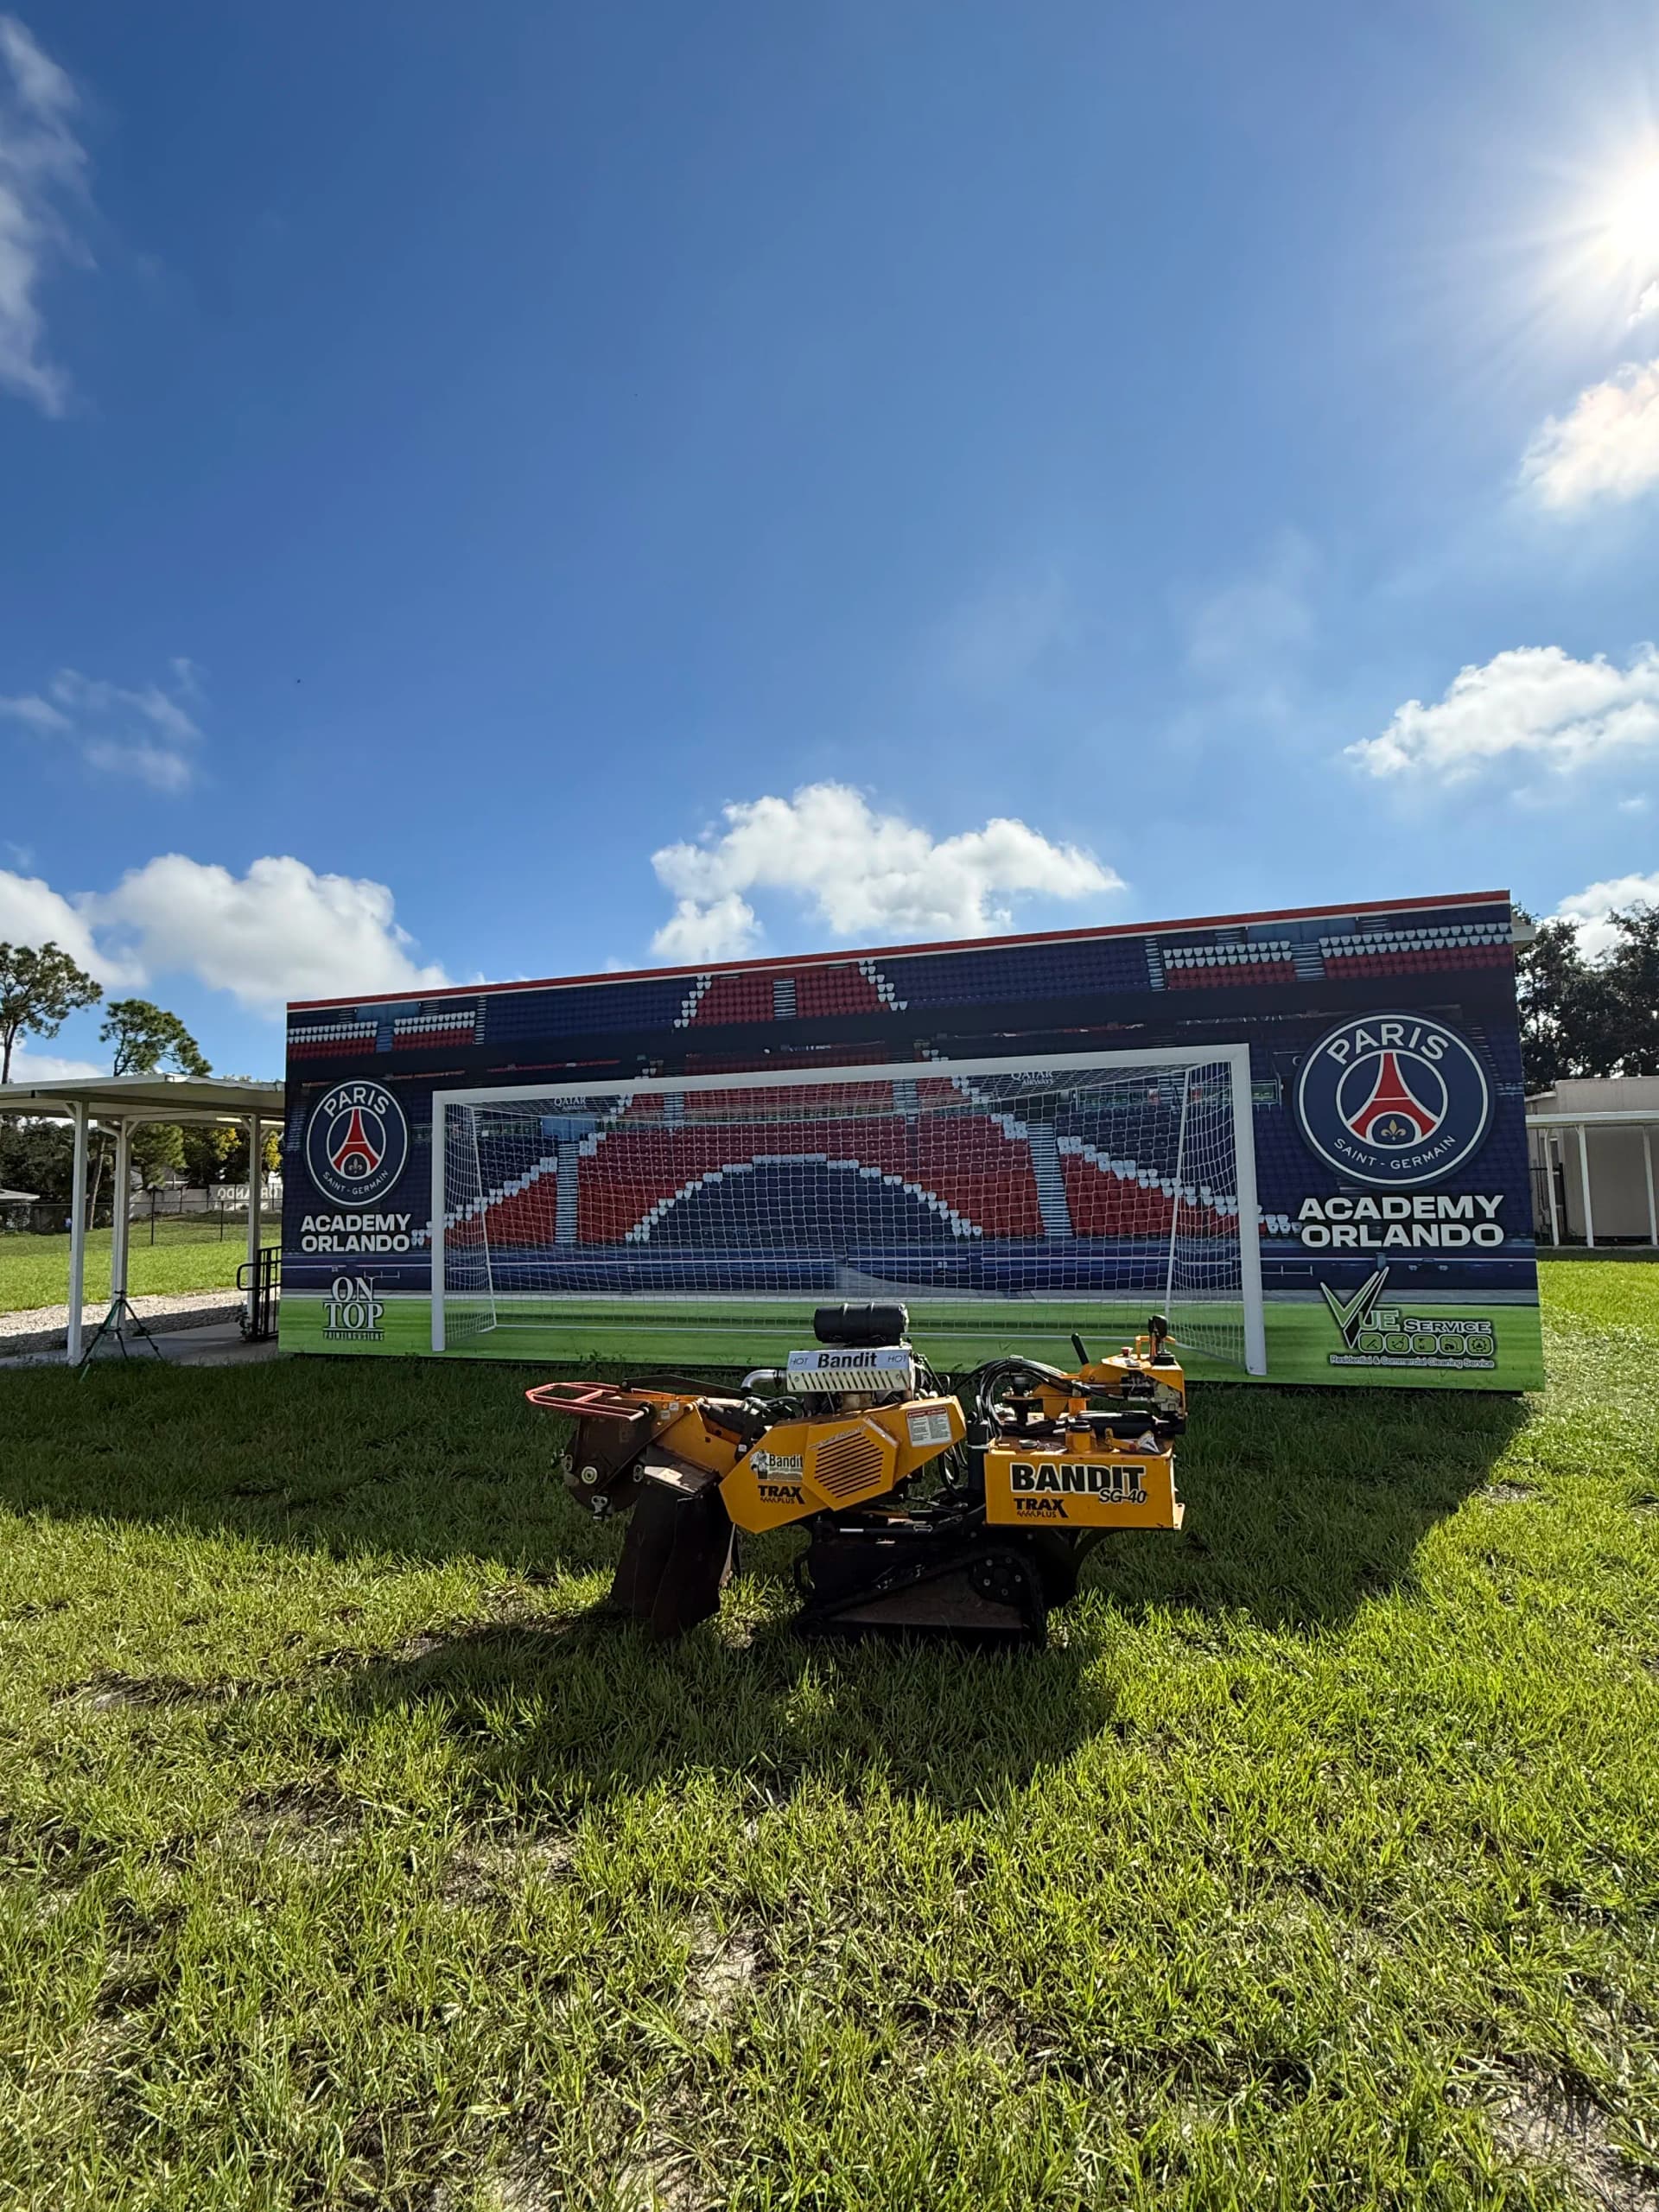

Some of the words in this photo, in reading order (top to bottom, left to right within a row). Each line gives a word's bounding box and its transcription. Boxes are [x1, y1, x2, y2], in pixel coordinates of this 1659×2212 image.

[1326, 1023, 1449, 1065] PARIS
[323, 1086, 390, 1116] PARIS
[1298, 1195, 1504, 1220] ACADEMY
[301, 1214, 411, 1231] ACADEMY
[302, 1234, 410, 1252] ORLANDO
[1301, 1224, 1504, 1248] ORLANDO
[332, 1276, 375, 1302] ON
[324, 1302, 383, 1329] TOP
[817, 1352, 877, 1369] Bandit
[1427, 1358, 1463, 1369] Cleaning
[769, 1453, 804, 1468] Bandit
[1011, 1463, 1146, 1494] BANDIT
[758, 1485, 805, 1504] TRAX
[1098, 1488, 1147, 1504] SG-40
[1014, 1497, 1069, 1518] TRAX
